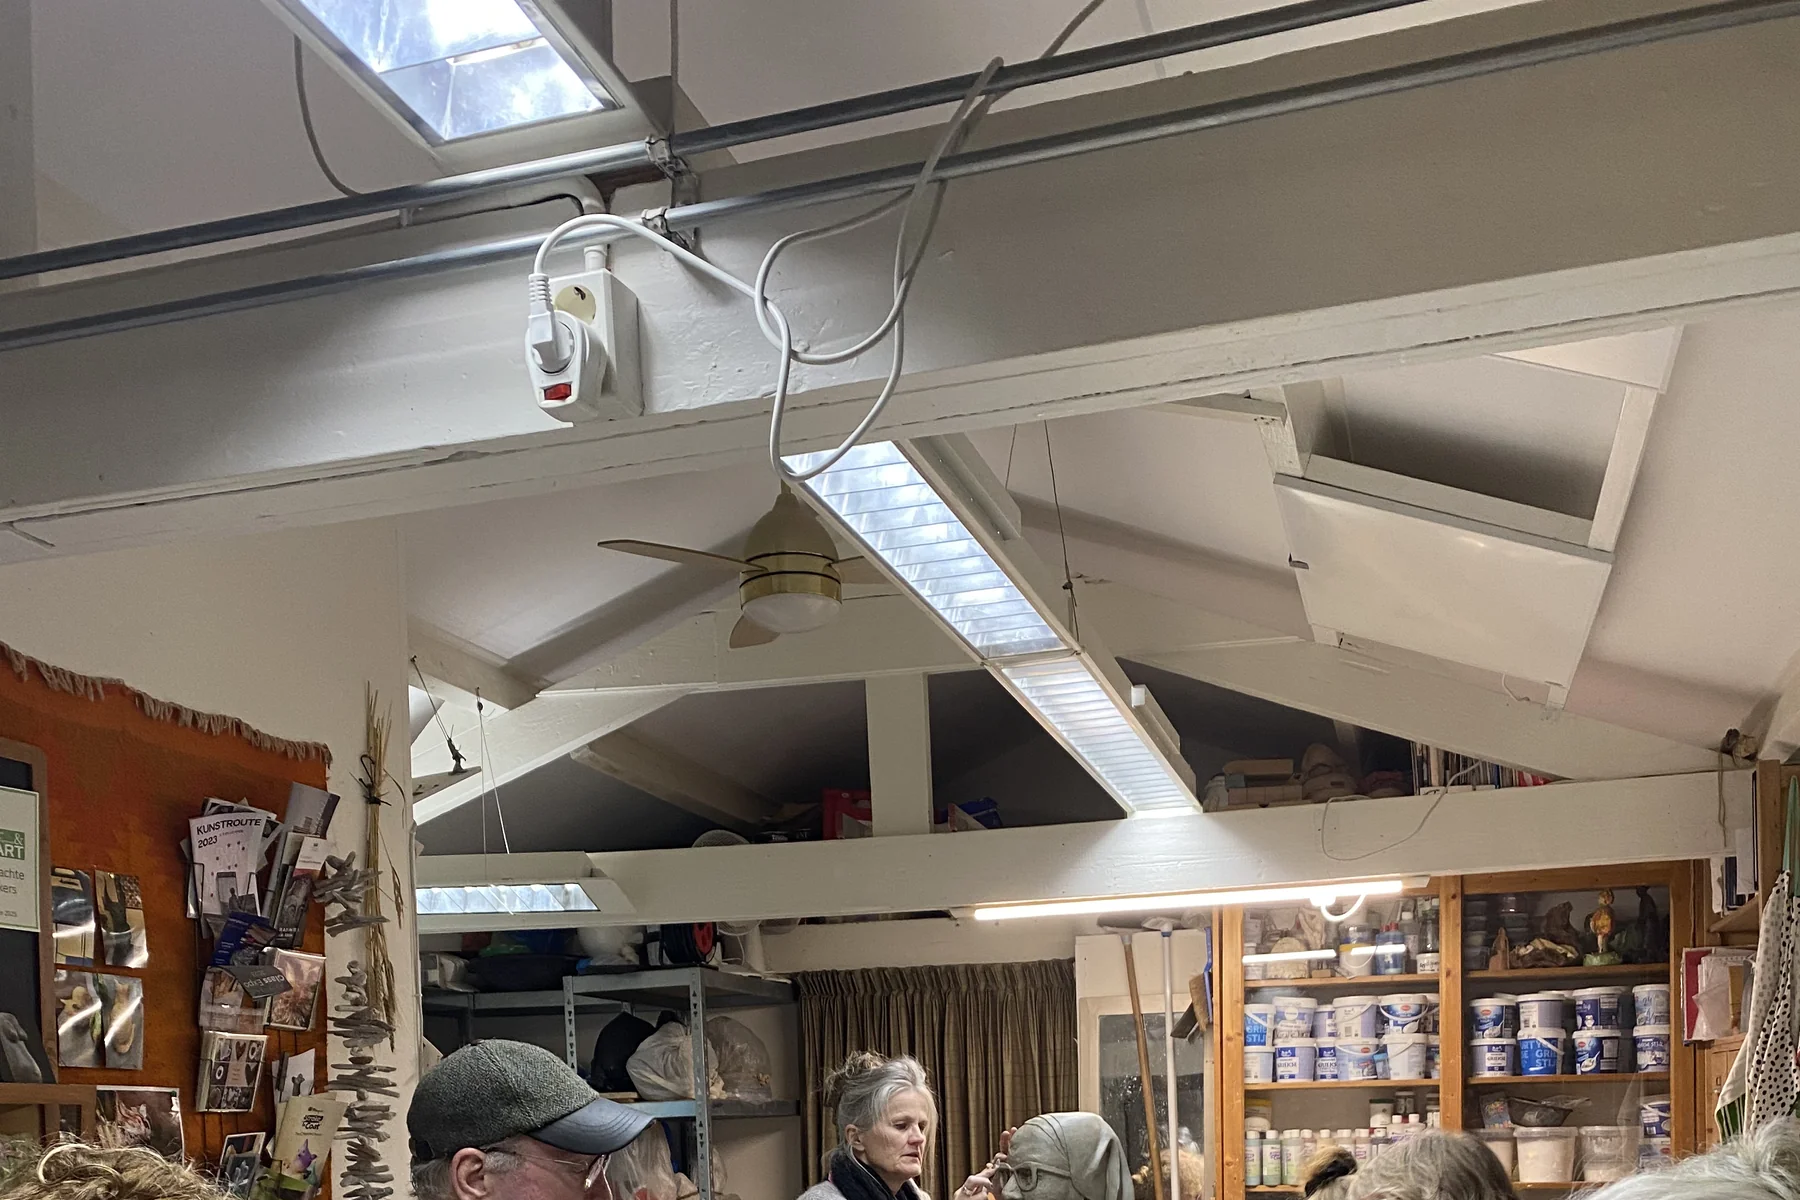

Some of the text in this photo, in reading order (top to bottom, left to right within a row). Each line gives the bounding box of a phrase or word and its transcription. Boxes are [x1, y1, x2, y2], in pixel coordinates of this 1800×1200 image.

[196, 819, 261, 835] KUNSTROUTE
[14, 832, 23, 845] &
[197, 835, 218, 848] 2023
